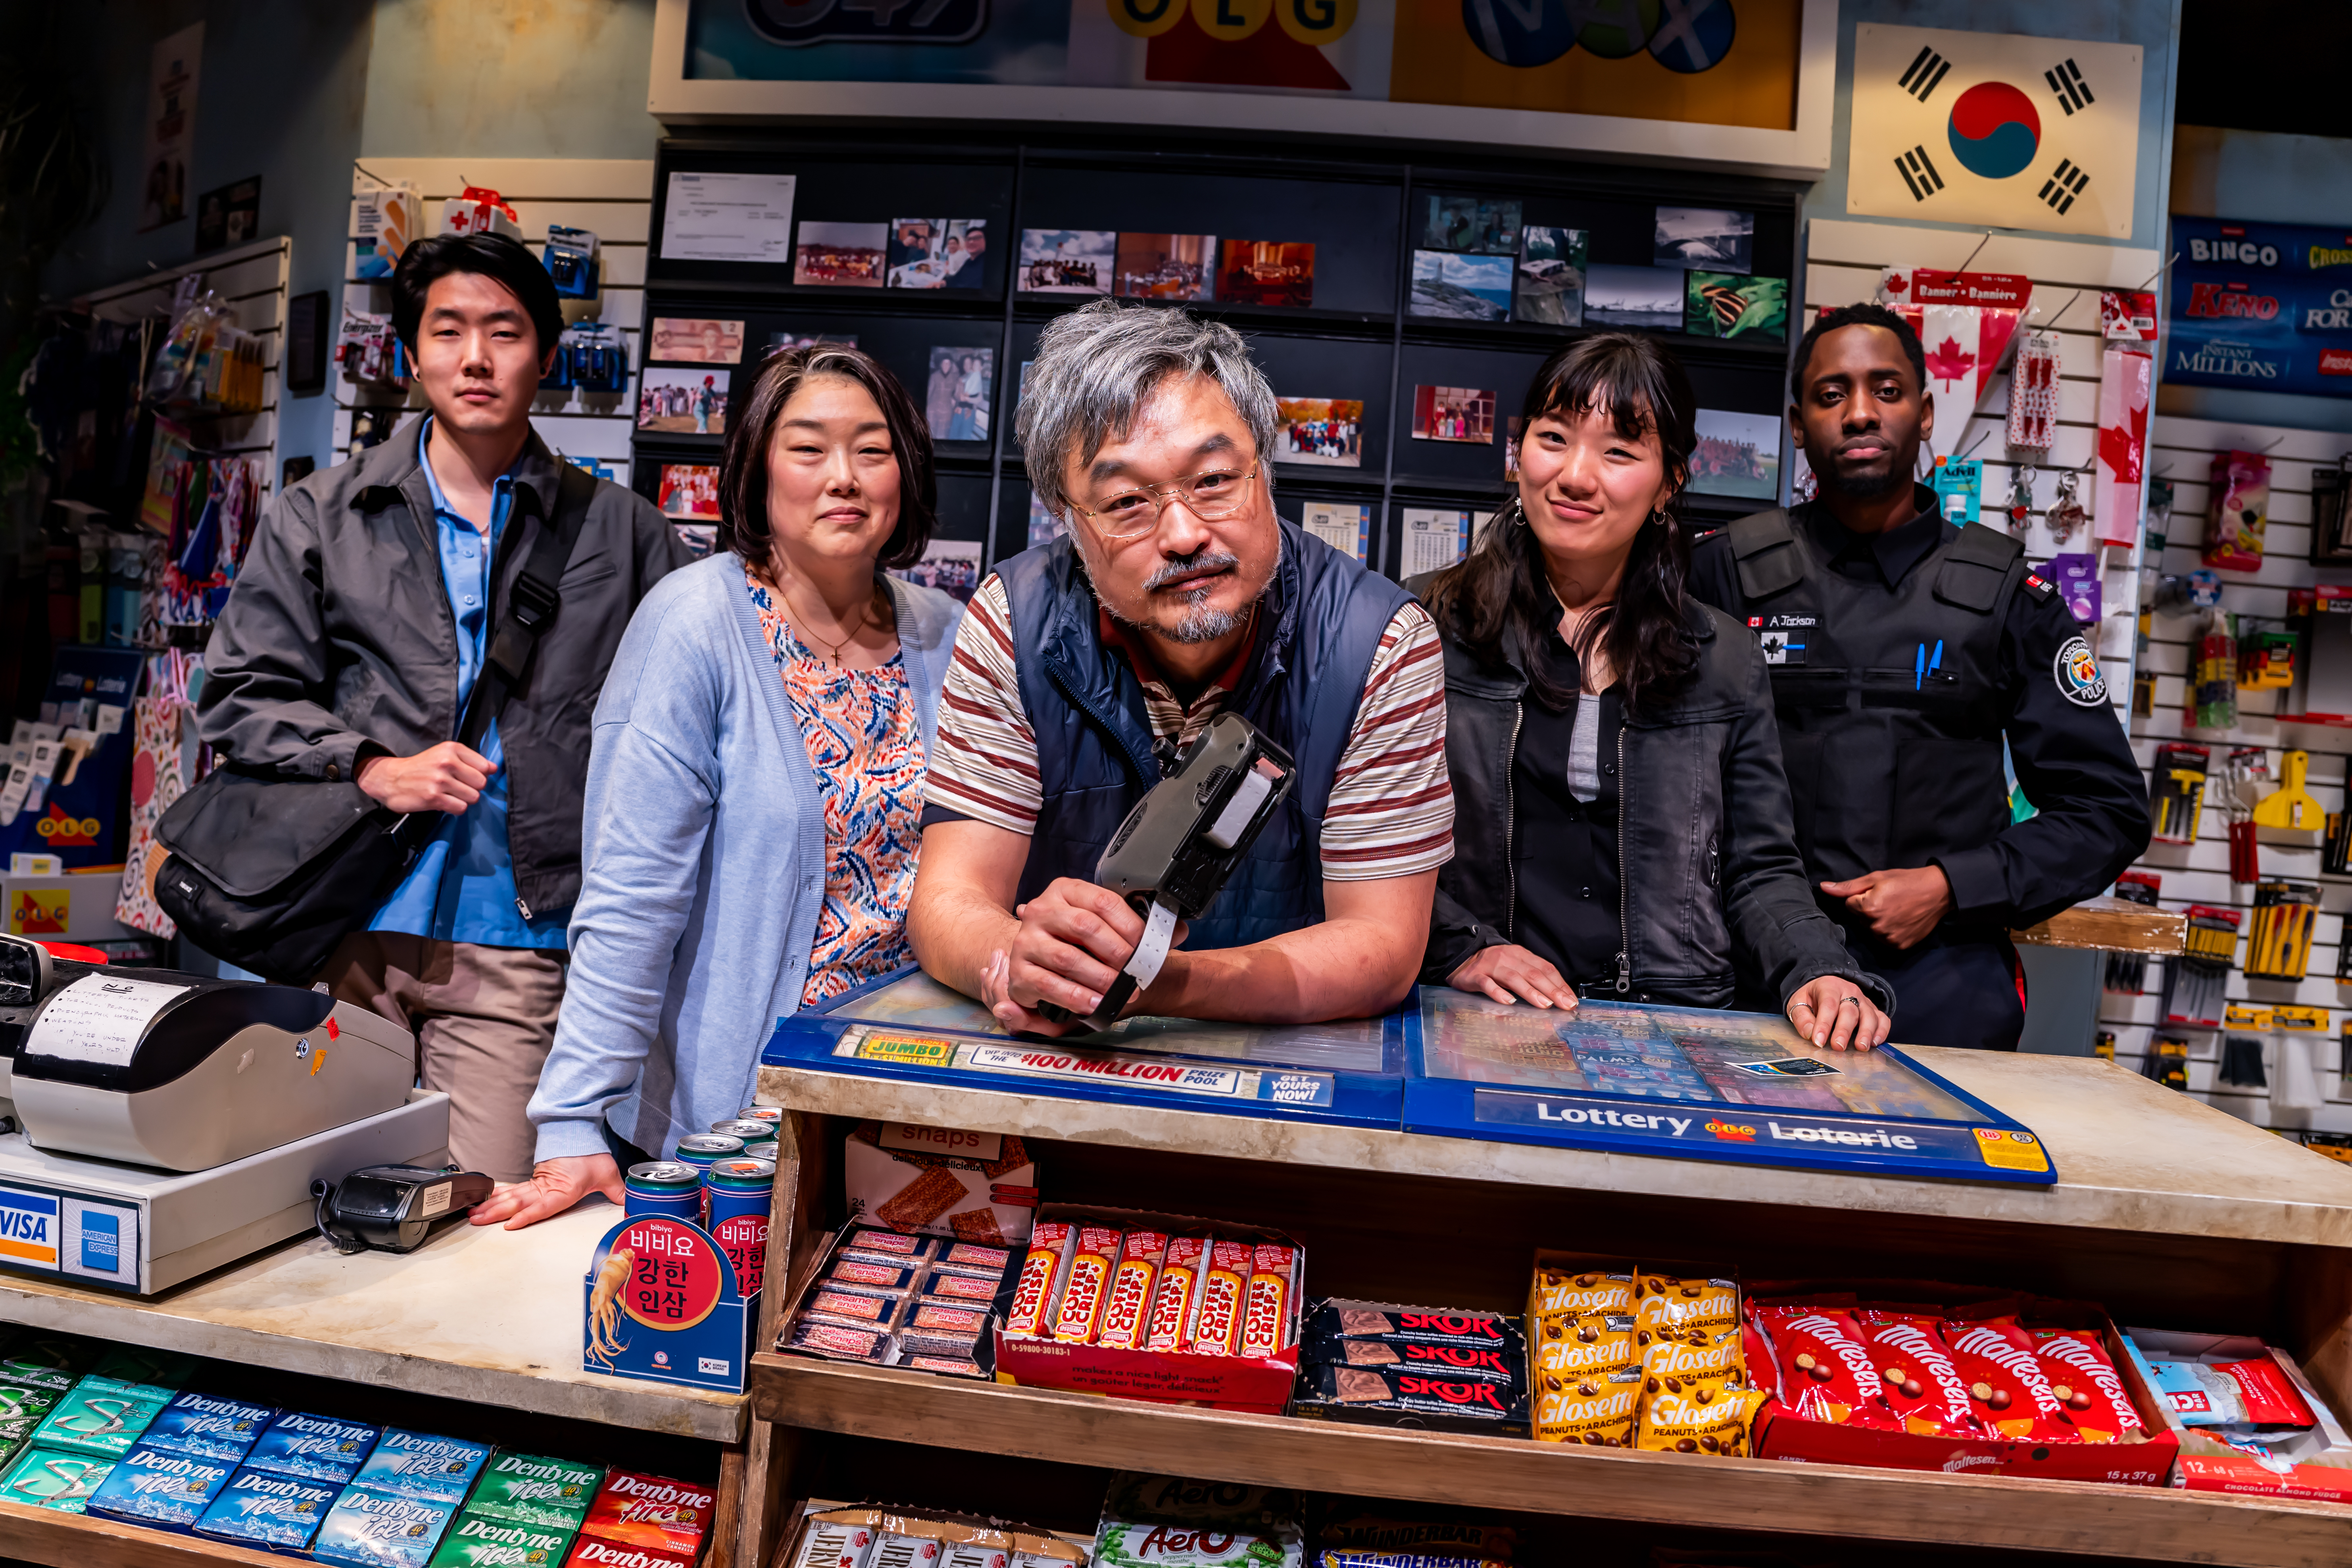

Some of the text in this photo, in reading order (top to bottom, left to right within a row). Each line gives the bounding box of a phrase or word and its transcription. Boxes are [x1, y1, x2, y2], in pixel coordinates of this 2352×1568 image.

[2190, 239, 2279, 267] BINGO
[1920, 284, 1958, 297] Banner
[2186, 282, 2279, 320] KENO
[729, 322, 736, 331] 2
[2305, 309, 2350, 328] FOR
[2202, 344, 2252, 359] INSTANT
[2176, 351, 2277, 378] MILLIONS
[1942, 466, 1975, 477] Advil
[1769, 616, 1779, 627] A
[2081, 679, 2105, 699] POLICE
[41, 821, 95, 832] OLG
[15, 908, 65, 921] OLG
[73, 989, 110, 998] LOTTERY
[107, 1003, 139, 1014] PRODUCTS
[872, 1041, 942, 1057] JUMBO
[901, 1037, 947, 1046] MILLIONS
[1020, 1053, 1186, 1082] $100 MILLION
[1576, 1053, 1637, 1065] PALMS
[1183, 1074, 1218, 1087] POOL
[1188, 1068, 1229, 1081] PRIZE
[1271, 1081, 1321, 1090] YOURS
[1272, 1090, 1316, 1101] NOW!
[1537, 1103, 1918, 1150] Lottery OLG Loterie
[901, 1125, 980, 1148] snaps
[852, 1197, 865, 1208] 24
[0, 1210, 47, 1242] VISA
[650, 1223, 673, 1233] bibiyo
[81, 1230, 116, 1243] AMERICAN
[630, 1230, 695, 1257] 비비요
[722, 1225, 769, 1245] 비비요
[867, 1231, 907, 1242] sesame
[874, 1237, 907, 1247] snaps
[88, 1242, 118, 1256] EXPRESS
[964, 1245, 1005, 1257] sesame
[970, 1252, 1003, 1261] snaps
[727, 1246, 767, 1270] 강한
[637, 1257, 689, 1289] 강한
[848, 1262, 890, 1273] sesame
[856, 1270, 888, 1280] snaps
[950, 1277, 992, 1287] sesame
[1010, 1257, 1039, 1319] COFFEE
[1021, 1269, 1047, 1317] CRISP
[1062, 1261, 1091, 1322] COFFEE
[1076, 1274, 1100, 1323] CRISP
[1106, 1268, 1136, 1330] COFFEE
[638, 1289, 687, 1319] 인삼
[1120, 1280, 1145, 1331] CRISP
[1151, 1273, 1175, 1336] COFFEE
[1162, 1286, 1185, 1335] CRISP
[1641, 1293, 1735, 1324] Glosette
[1401, 1313, 1503, 1339] SKOR
[1011, 1343, 1071, 1357] 0-59800-30183-1
[1785, 1314, 1883, 1399] Maltesers
[1406, 1345, 1510, 1375] SKOR
[1072, 1365, 1112, 1376] makes
[1127, 1370, 1153, 1378] nice
[1155, 1371, 1180, 1382] light
[1874, 1324, 1972, 1417] Maltesers
[1954, 1327, 2062, 1412] Maltesers
[47, 1376, 72, 1385] Stride
[2037, 1336, 2142, 1429] Maltesers
[24, 1396, 50, 1407] 20
[1399, 1376, 1506, 1410] SKOR
[2195, 1393, 2205, 1409] BAR
[174, 1393, 270, 1422] Dentyne
[181, 1414, 230, 1434] ice
[276, 1414, 375, 1442] Dentyne
[1540, 1425, 1580, 1434] PEANUTS
[213, 1448, 244, 1457] PEPPERMINT
[285, 1434, 336, 1456] ice
[384, 1433, 484, 1462] Dentyne
[319, 1468, 352, 1477] PEPPERMINT
[394, 1454, 447, 1476] ice
[494, 1457, 596, 1485] Dentyne
[2187, 1461, 2235, 1478] 12 68 g
[2106, 1470, 2120, 1480] 15
[2131, 1470, 2146, 1481] 37
[2147, 1472, 2157, 1483] g
[507, 1478, 560, 1501] ice
[1155, 1480, 1249, 1508] Aero
[2224, 1483, 2312, 1497] CHOCOLATE ALMOND
[165, 1509, 198, 1519] PEPPERMINT
[173, 1515, 195, 1523] MENTHE
[619, 1498, 679, 1524] fire
[537, 1518, 558, 1526] MENTHE
[548, 1516, 578, 1524] SPEARMINT
[274, 1530, 307, 1540] PEPPERMINT
[283, 1535, 305, 1544] MENTHE
[1139, 1526, 1235, 1557] Aero
[1335, 1524, 1483, 1547] WUNDERBAR
[665, 1539, 695, 1549] CINNAMON
[667, 1543, 694, 1553] CANNELLE
[1330, 1550, 1483, 1568] WUNDERBAR
